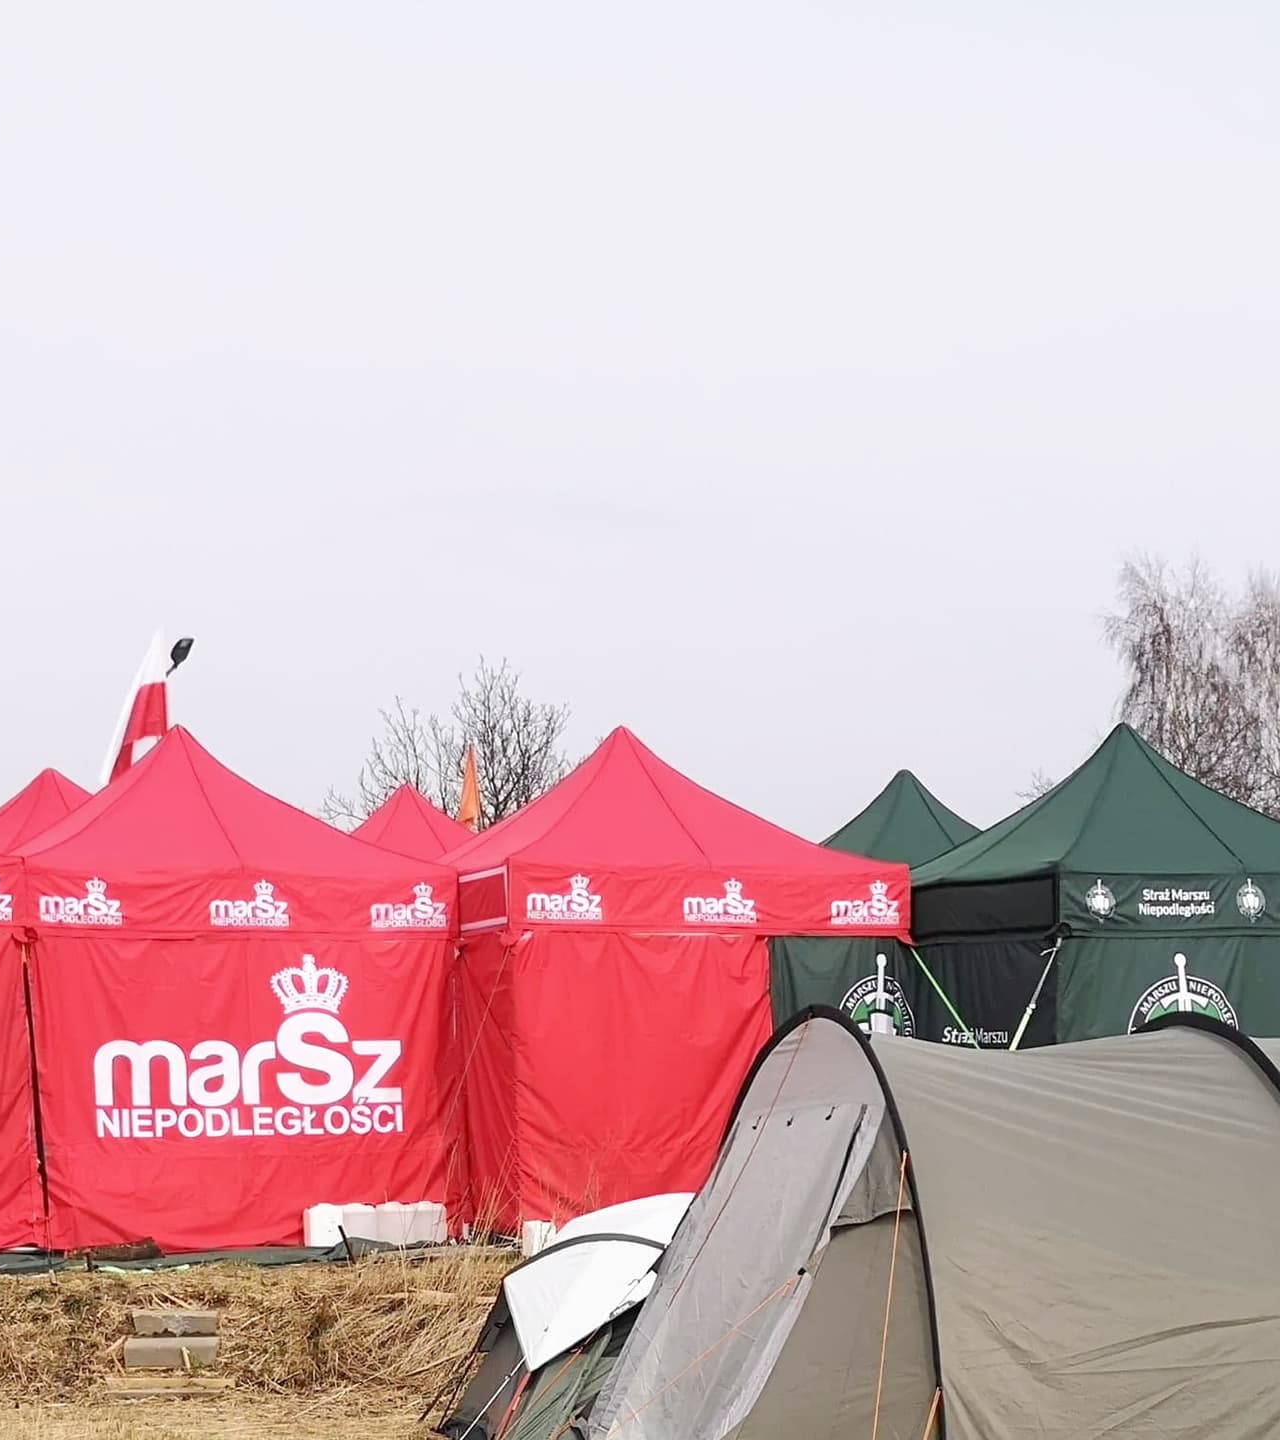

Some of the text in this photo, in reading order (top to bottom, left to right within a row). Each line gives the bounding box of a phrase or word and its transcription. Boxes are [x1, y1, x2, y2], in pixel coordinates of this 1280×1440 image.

[1142, 887, 1210, 901] Straż Marszu
[1138, 901, 1215, 917] Niepodległości
[1140, 981, 1235, 1028] MARSZU NIEPODLEG
[96, 1098, 404, 1138] NIEPODLEGŁOŚCI
